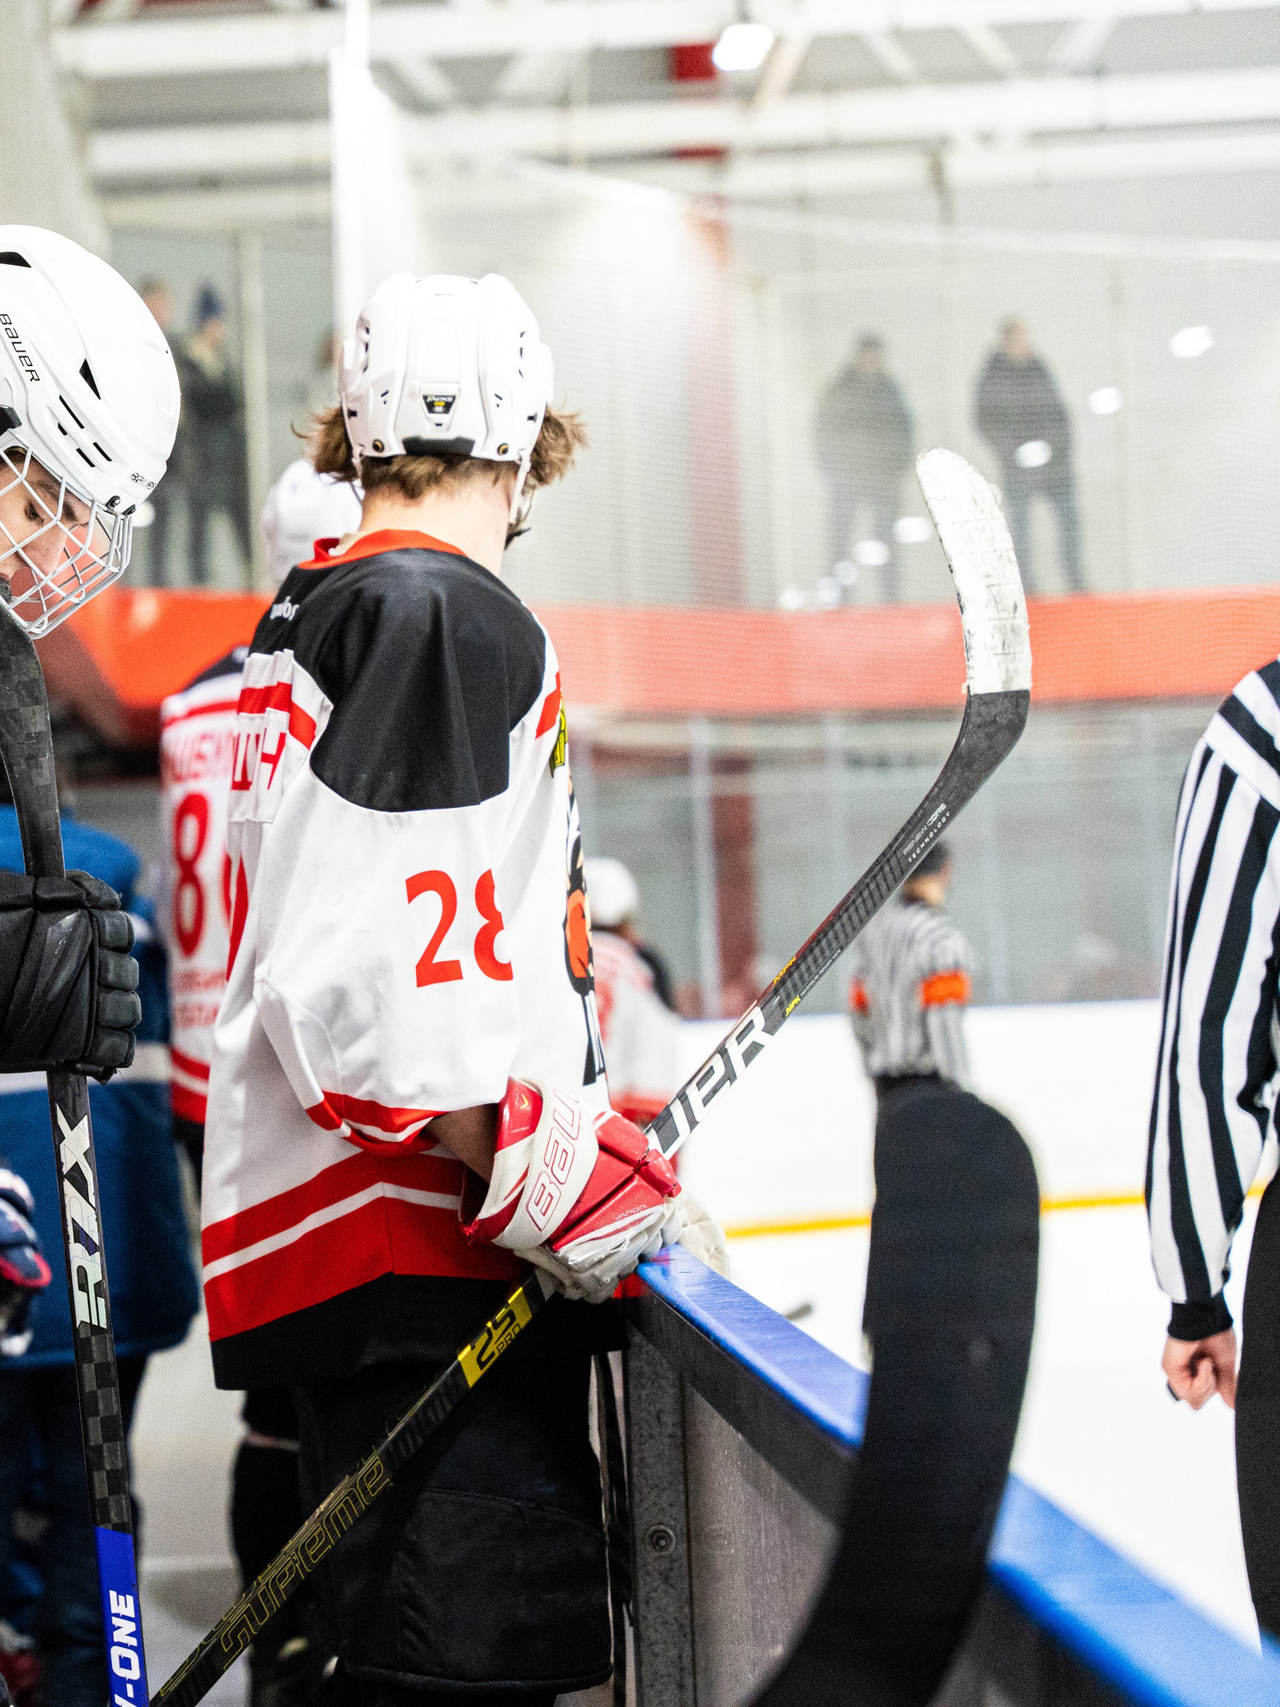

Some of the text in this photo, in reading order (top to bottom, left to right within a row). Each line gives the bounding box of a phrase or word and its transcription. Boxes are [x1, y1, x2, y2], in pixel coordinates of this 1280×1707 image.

[405, 868, 514, 989] 28
[648, 1006, 774, 1161] UER
[495, 1322, 522, 1355] PRO
